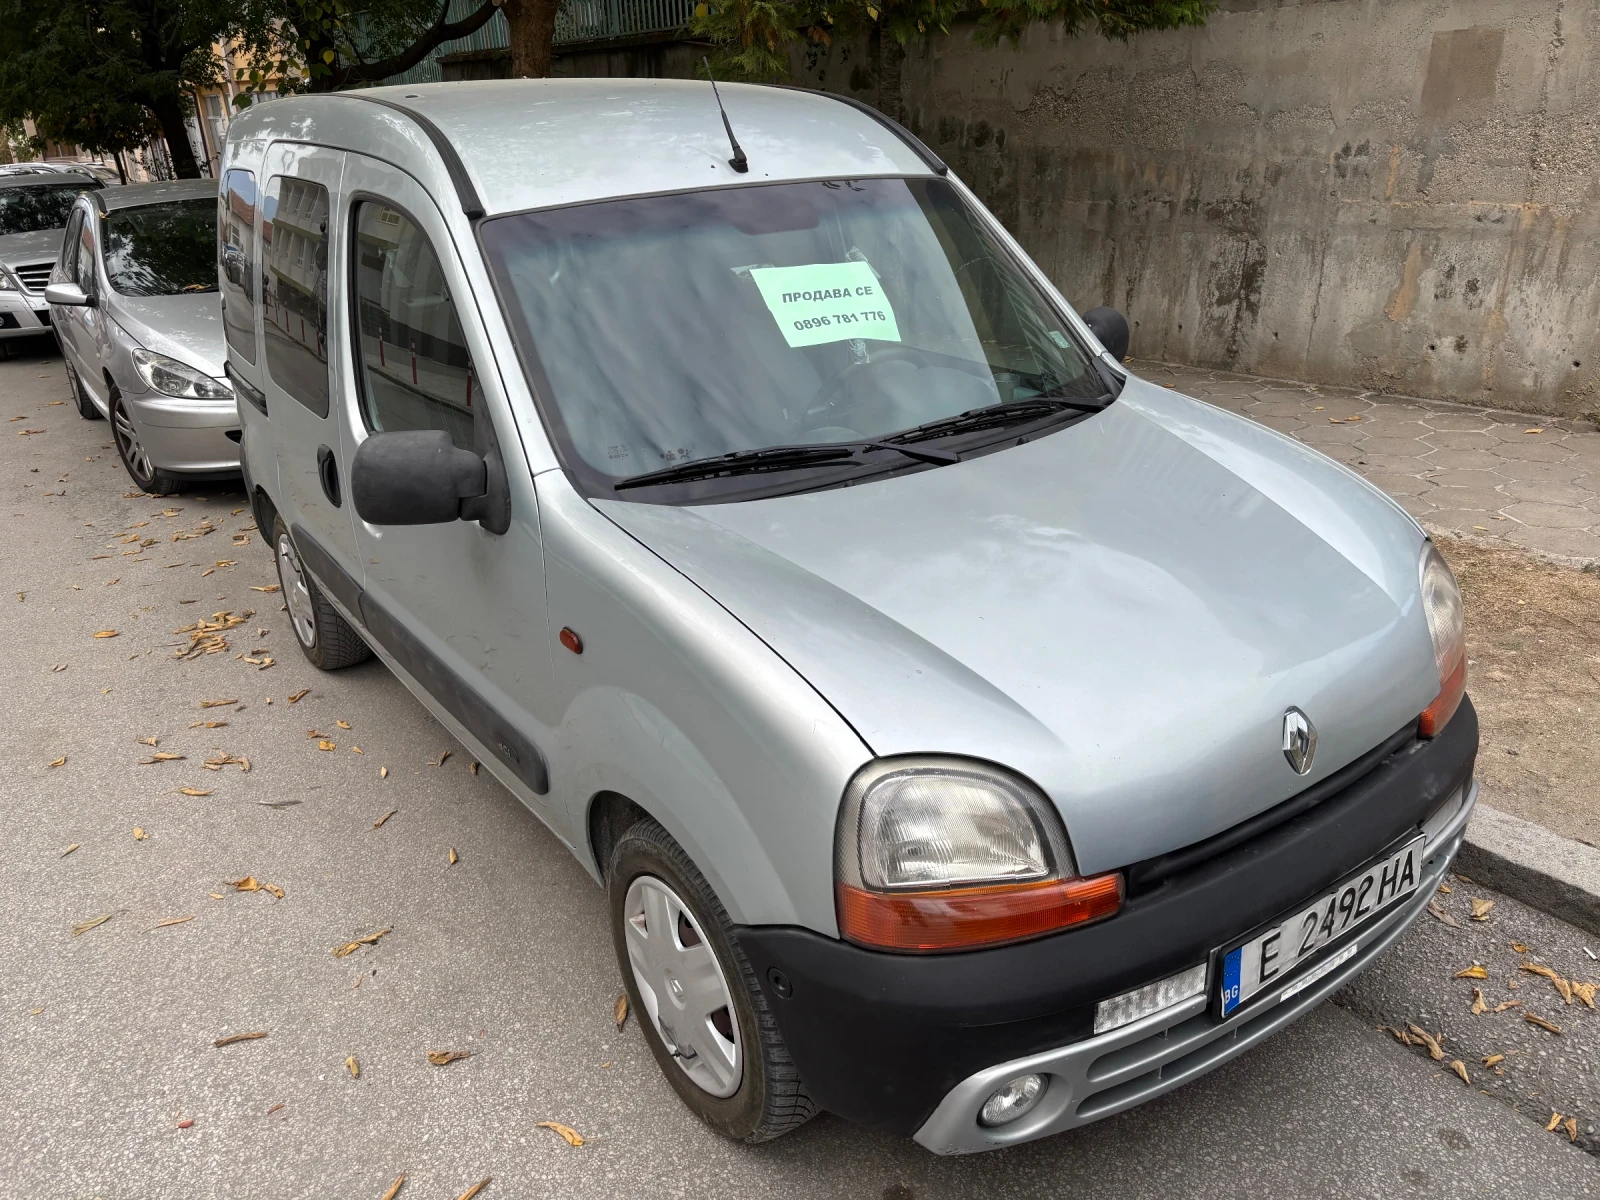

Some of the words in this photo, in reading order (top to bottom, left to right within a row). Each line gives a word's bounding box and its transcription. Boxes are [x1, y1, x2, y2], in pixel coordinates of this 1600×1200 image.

[782, 288, 852, 303] ПРОДАВА
[855, 286, 873, 296] СЕ
[793, 316, 831, 331] 0896
[832, 313, 859, 324] 781
[860, 311, 886, 321] 776
[1298, 875, 1374, 957] 2492
[1224, 984, 1239, 1005] BG
